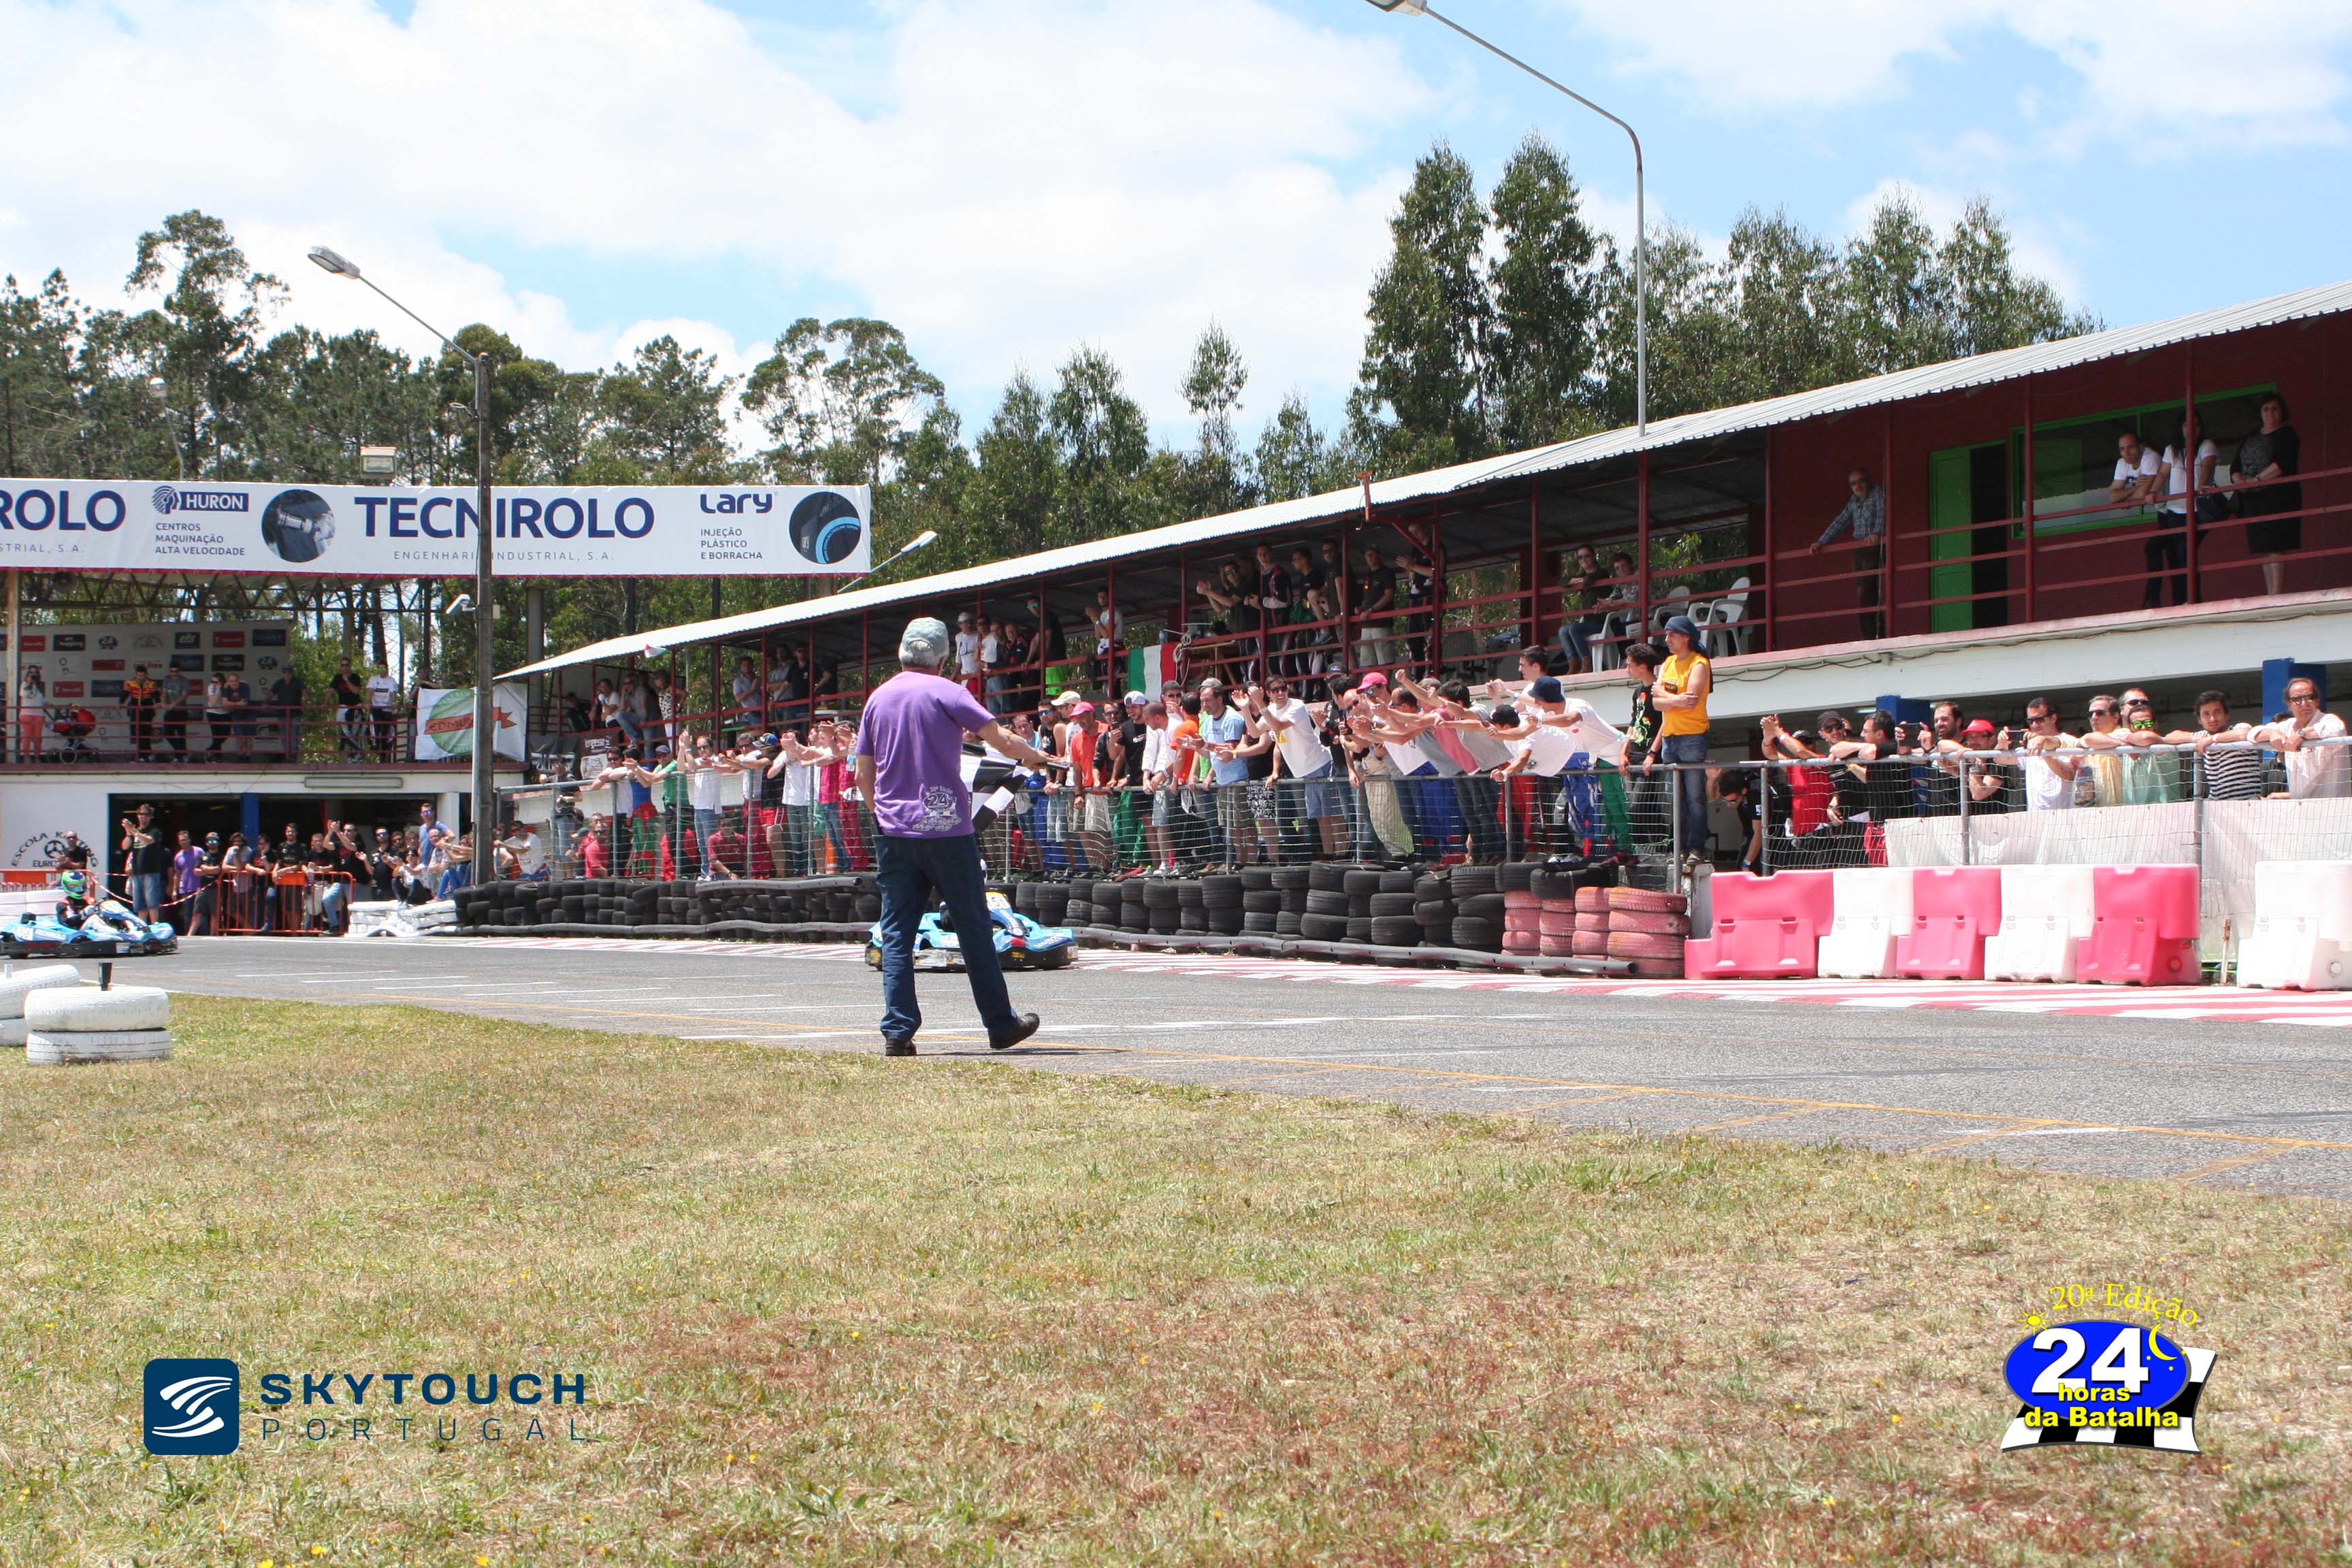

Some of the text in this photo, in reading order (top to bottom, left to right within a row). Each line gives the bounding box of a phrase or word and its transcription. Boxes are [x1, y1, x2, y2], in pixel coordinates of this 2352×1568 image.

[185, 494, 244, 510] HURON
[354, 496, 655, 539] TECNIROLO
[155, 523, 201, 532] CENTROS
[700, 527, 742, 539] INJEÇÃO
[155, 534, 224, 545] MAQUINAÇÃO
[700, 539, 747, 548] PLÁSTICO
[57, 544, 85, 553] S.A.
[154, 546, 246, 556] ALTA VELOCIDADE
[393, 551, 475, 560] ENGENHARI
[587, 551, 615, 561] S.A.
[700, 551, 763, 560] E BORRACHA
[927, 794, 949, 808] 24
[11, 832, 49, 867] ESCOLA
[33, 860, 59, 868] EURO
